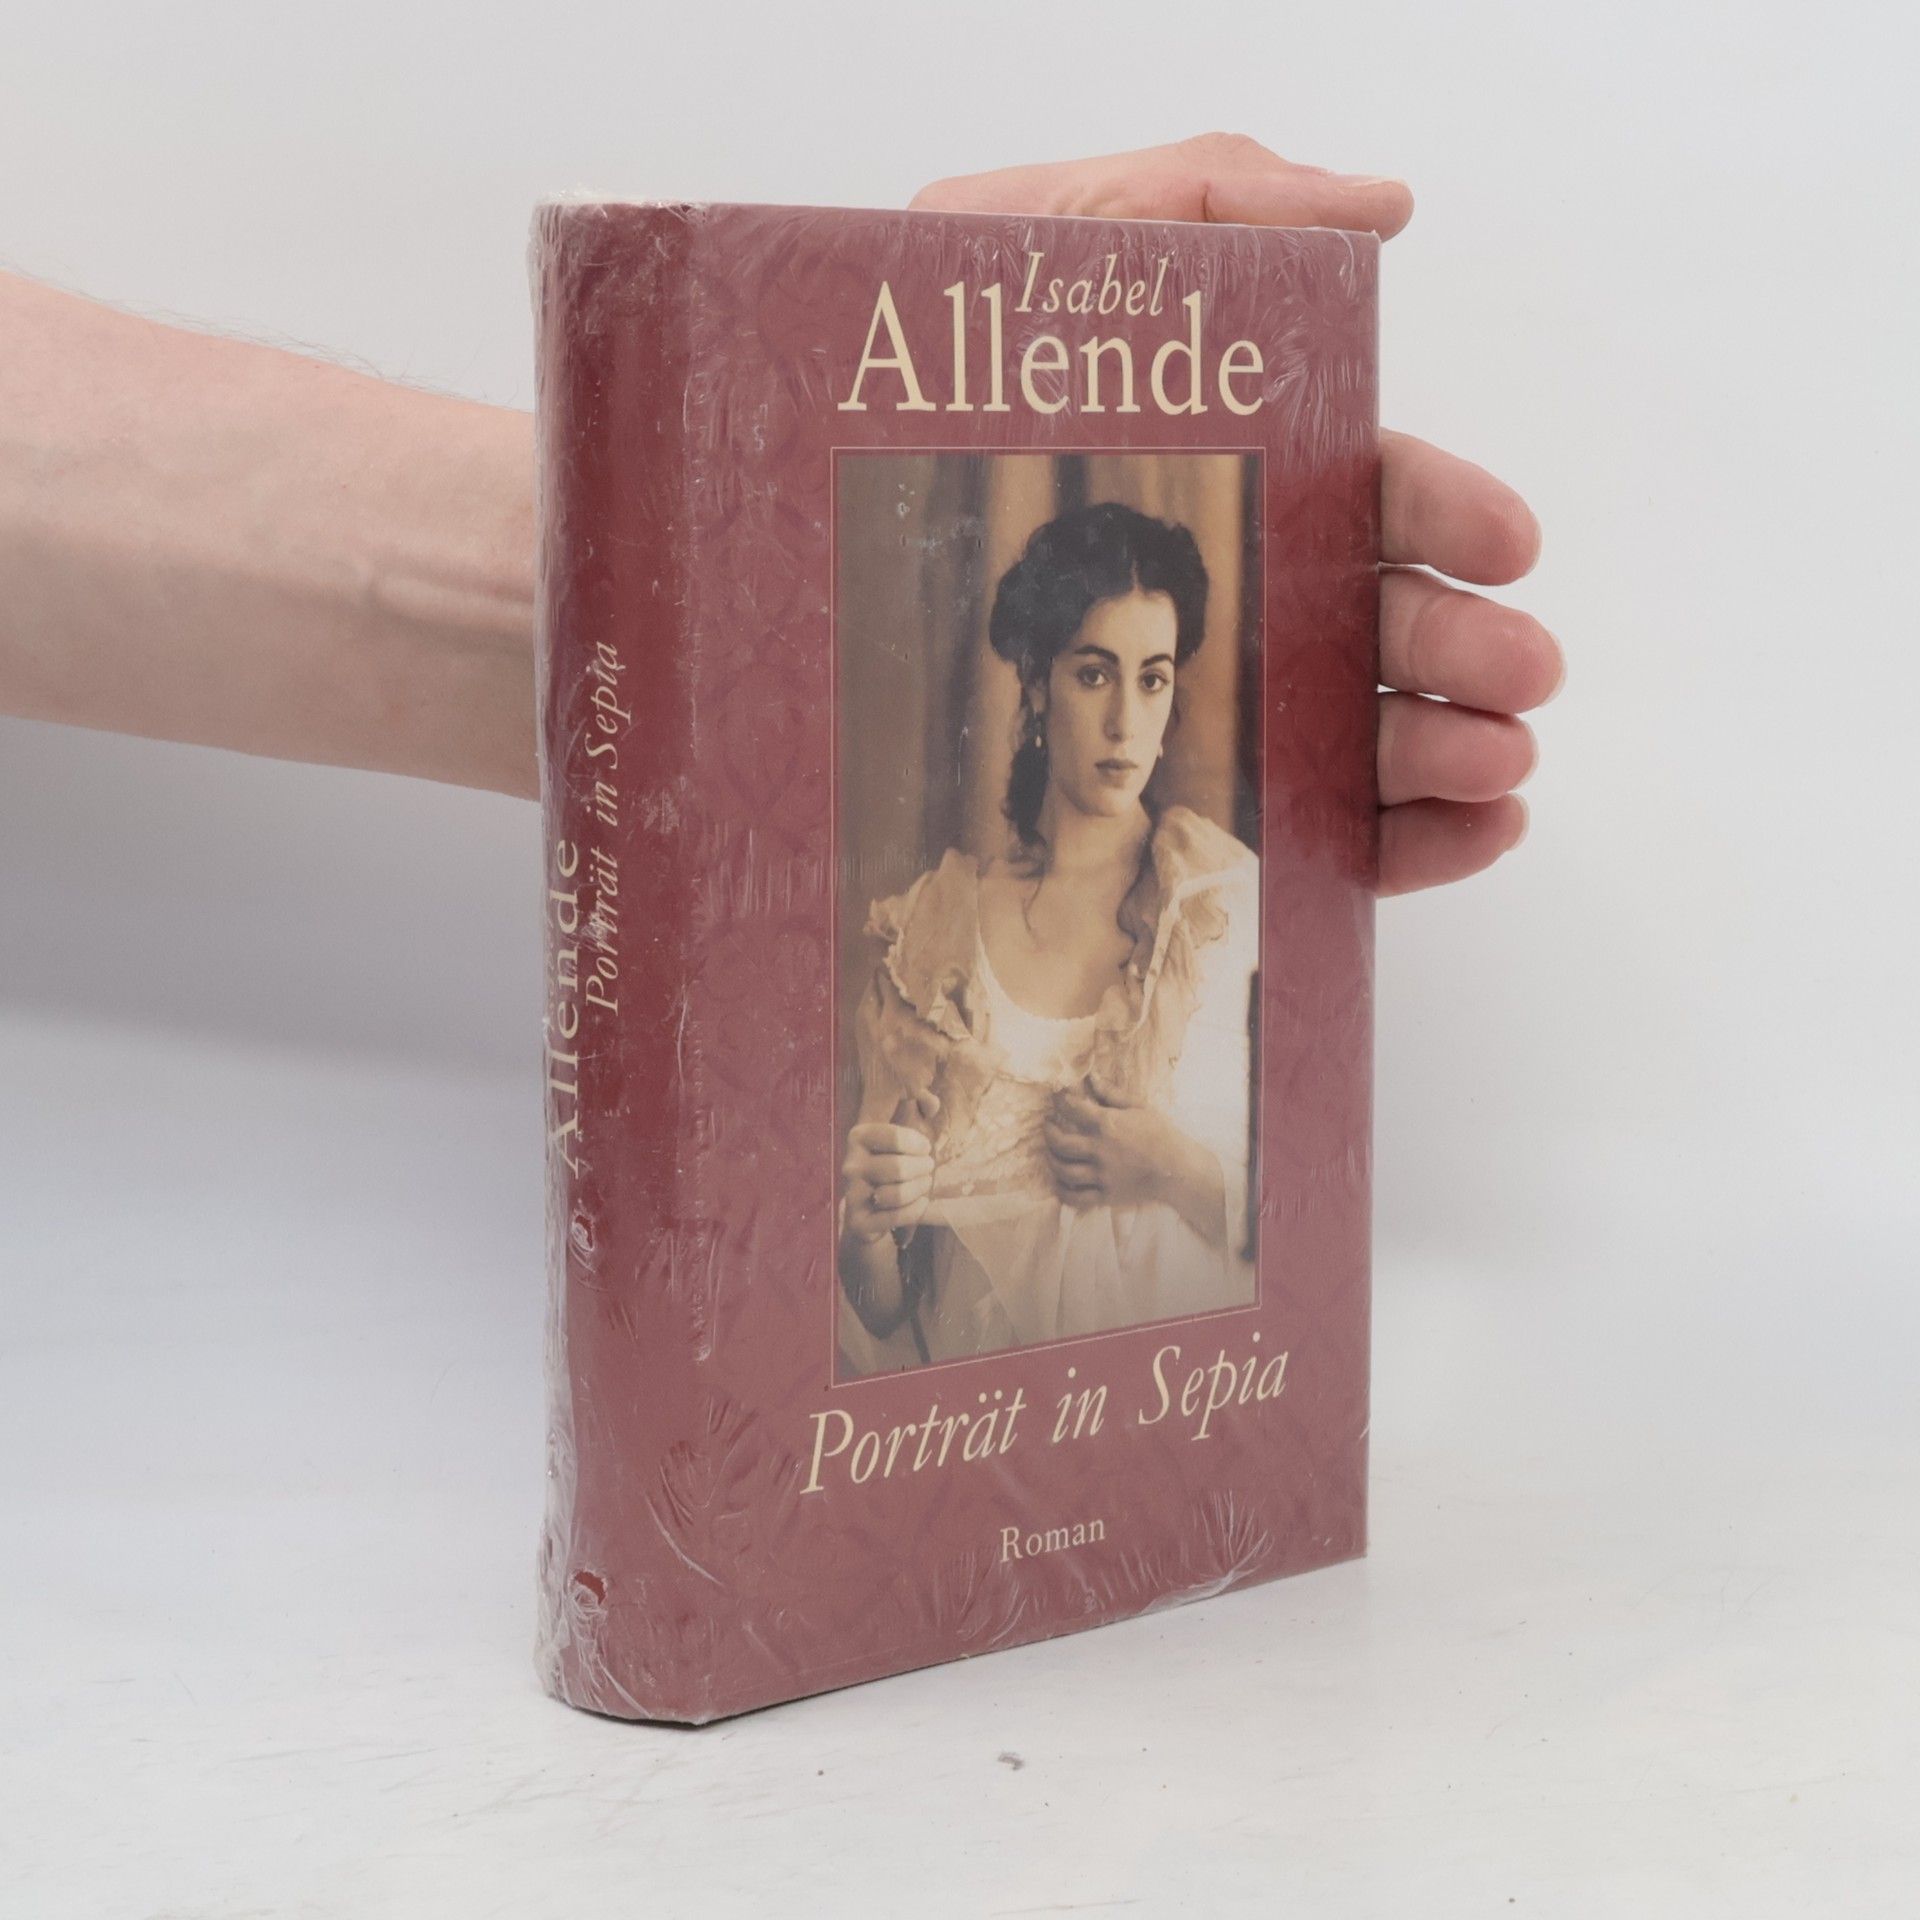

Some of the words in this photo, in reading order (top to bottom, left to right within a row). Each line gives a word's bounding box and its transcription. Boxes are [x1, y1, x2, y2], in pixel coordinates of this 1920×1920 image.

[837, 281, 1265, 416] Allende
[1015, 252, 1169, 316] Isabel
[584, 641, 631, 770] Sepia
[586, 781, 618, 827] in
[585, 845, 619, 1017] Porträt
[549, 839, 579, 1180] Allende
[800, 1387, 1026, 1495] Porträt
[1051, 1367, 1108, 1444] in
[1138, 1331, 1290, 1441] Sepia
[1000, 1518, 1106, 1563] Roman
